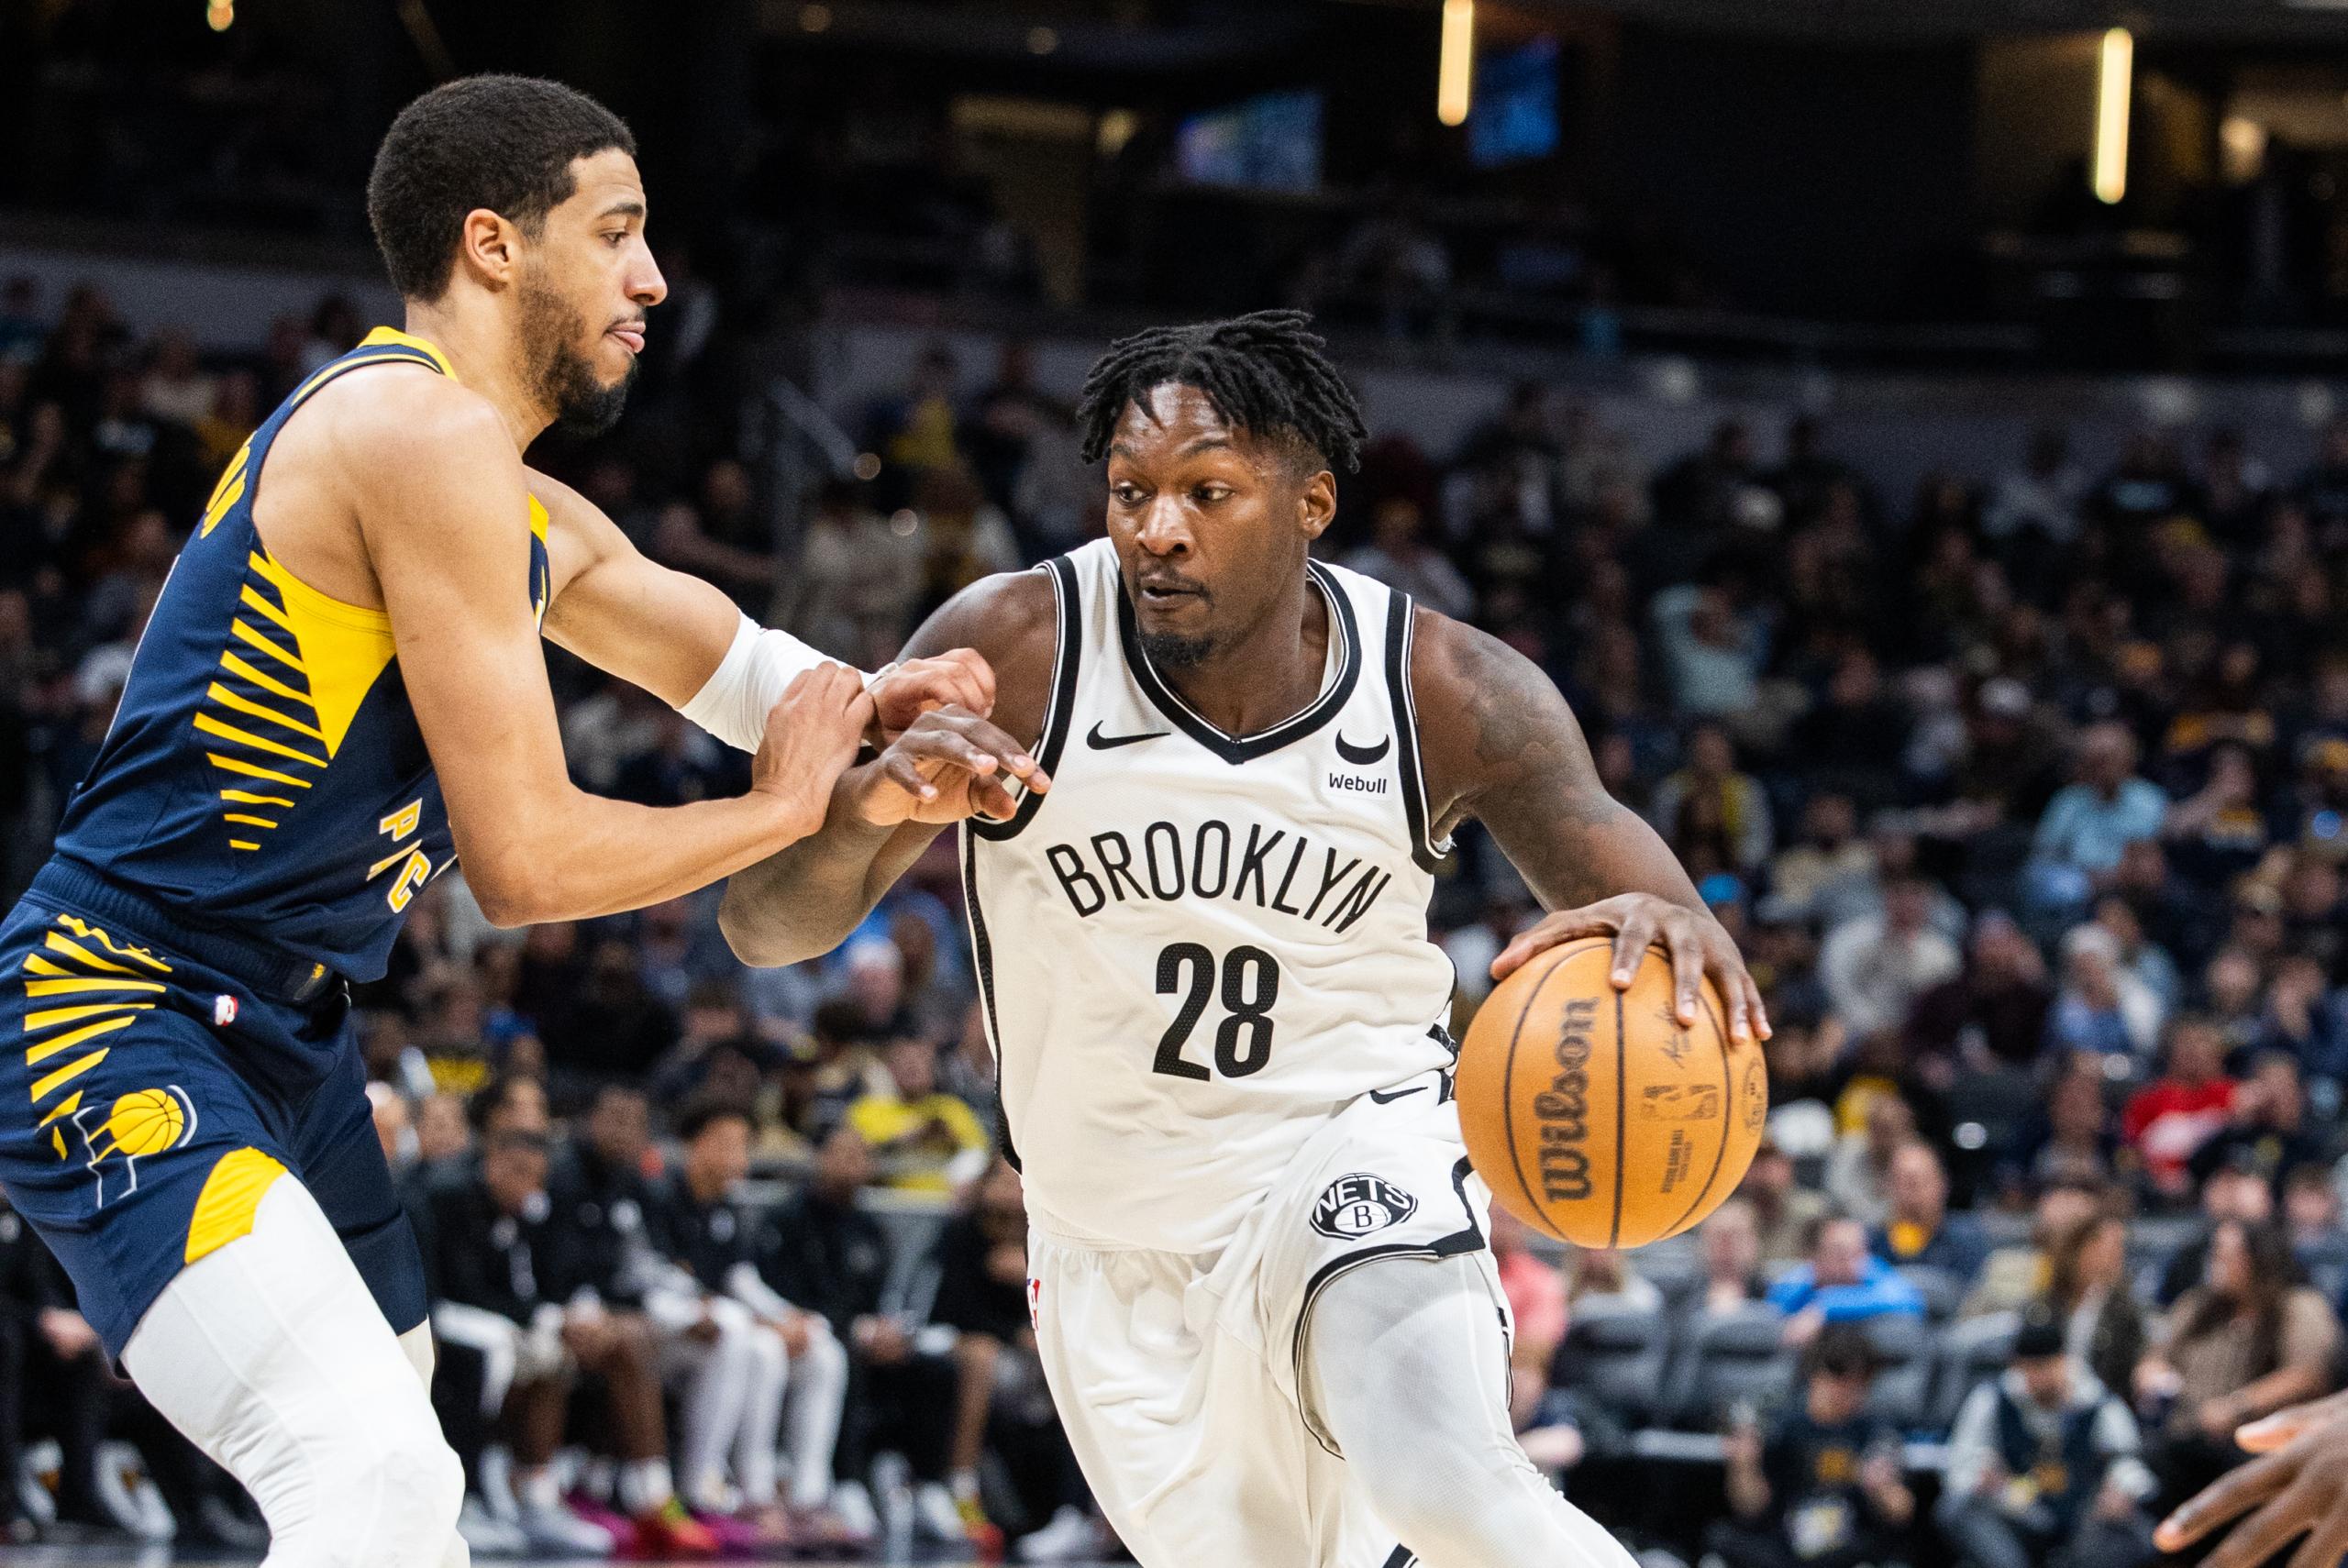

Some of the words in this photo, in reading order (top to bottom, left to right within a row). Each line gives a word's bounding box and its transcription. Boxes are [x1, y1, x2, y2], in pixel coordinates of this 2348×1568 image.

[1329, 772, 1387, 794] Webull
[1046, 820, 1392, 934] BROOKLYN
[1152, 942, 1280, 1082] 28
[1315, 1176, 1411, 1223] NETS
[1354, 1205, 1372, 1228] B
